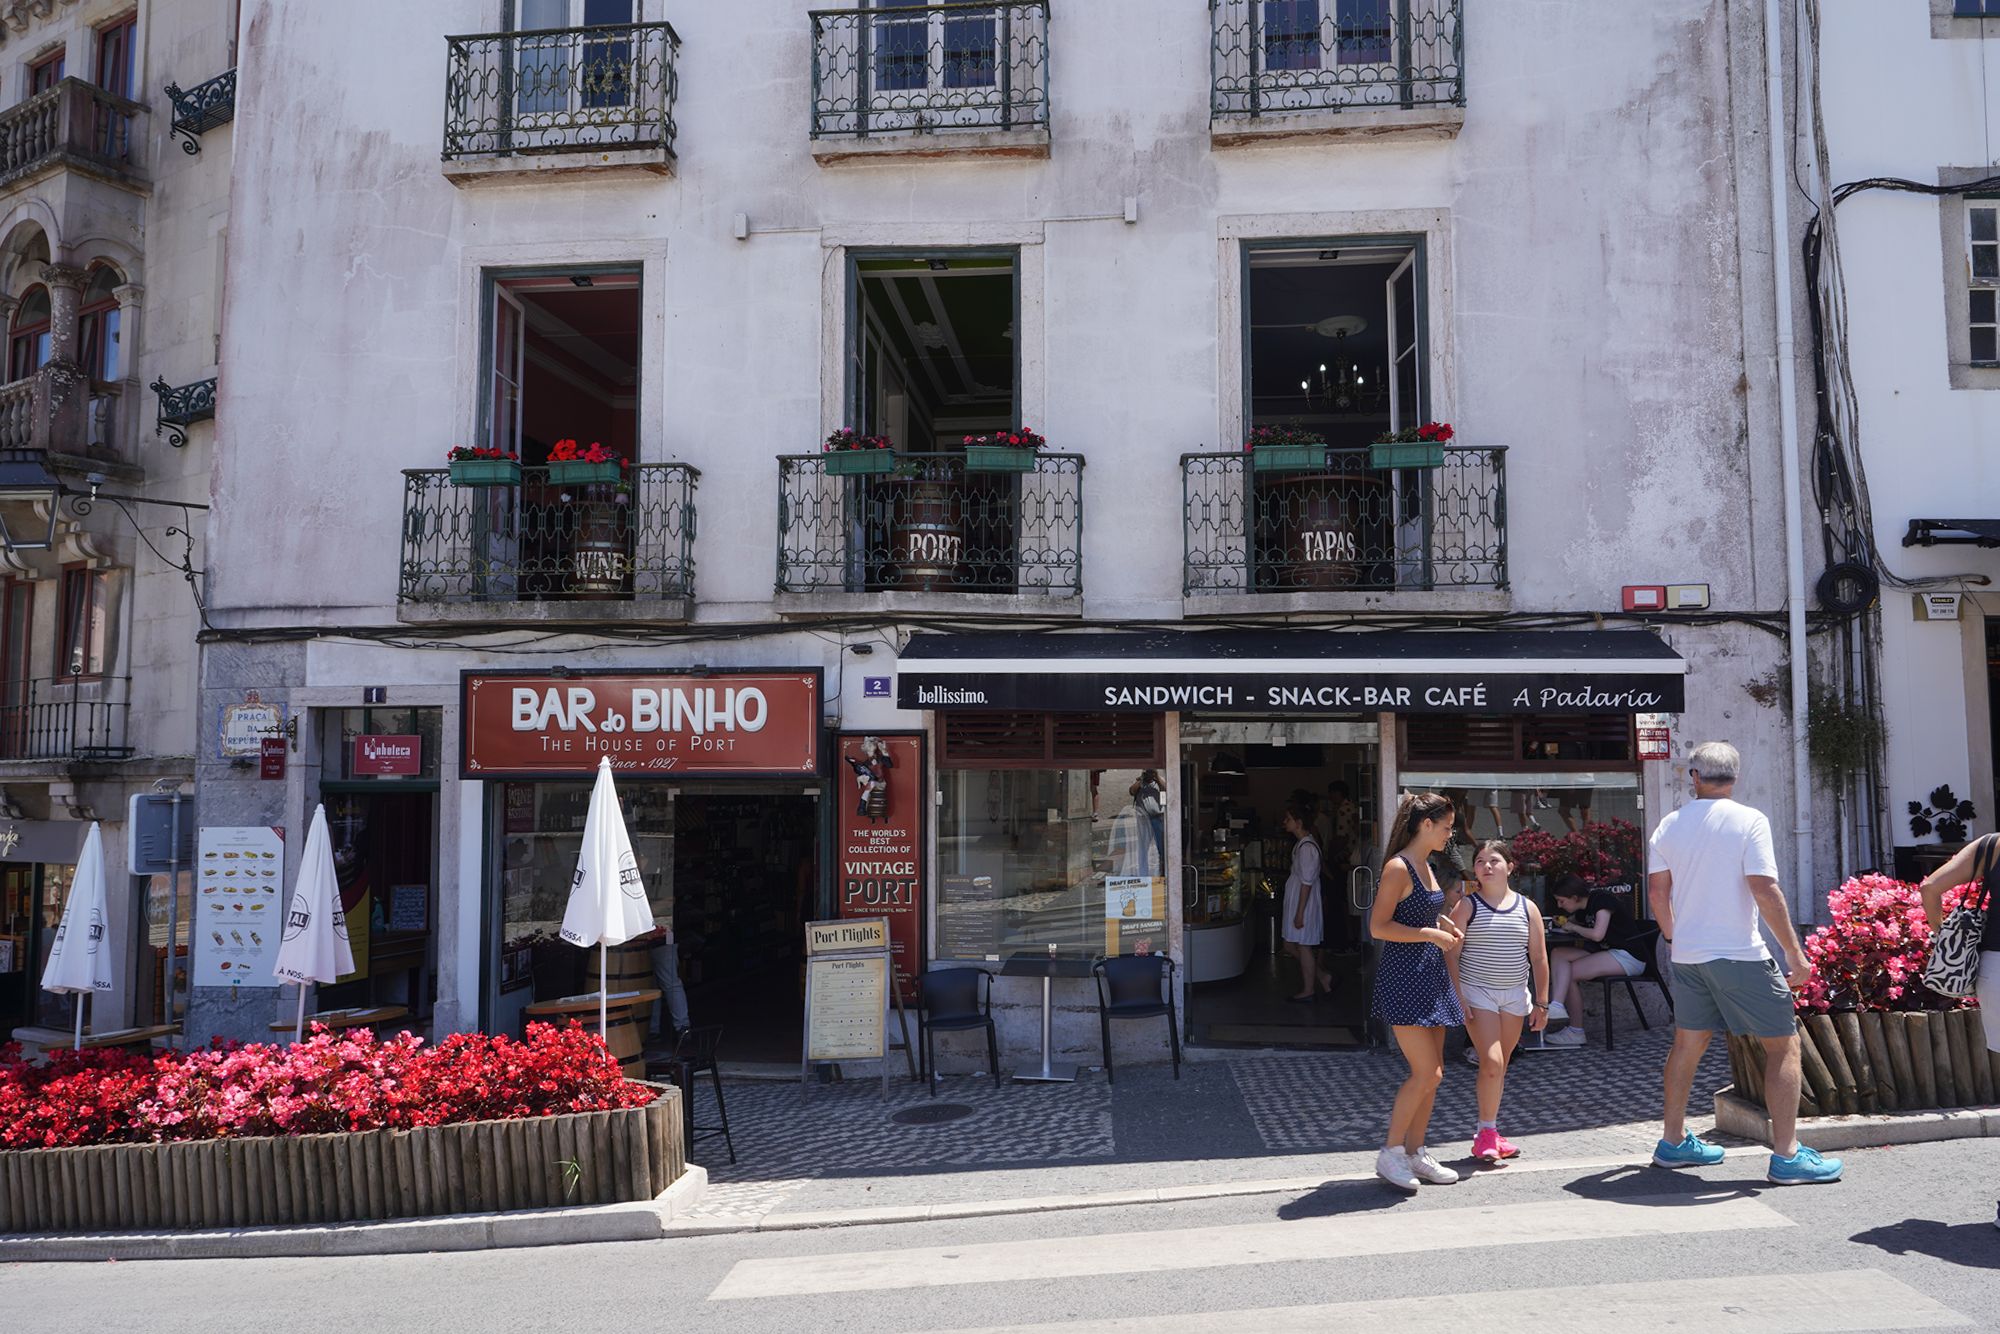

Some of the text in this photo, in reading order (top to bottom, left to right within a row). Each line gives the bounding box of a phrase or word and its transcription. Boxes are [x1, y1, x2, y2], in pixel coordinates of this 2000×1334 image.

[910, 533, 962, 565] PORT
[1301, 531, 1356, 561] TAPAS
[576, 551, 624, 580] WINE
[873, 680, 881, 690] 2
[372, 688, 377, 702] 1
[918, 685, 989, 704] bellissimo.
[1104, 686, 1233, 705] SANDWICH
[1267, 686, 1411, 706] SNACK-BAR
[1424, 682, 1488, 706] CAFÉ
[1512, 687, 1531, 707] A
[237, 713, 267, 722] PRAÇA
[512, 687, 768, 735] BAR do BINHO
[247, 725, 258, 733] DA
[228, 735, 262, 745] REPÚBL
[647, 757, 679, 770] 1927
[853, 829, 906, 837] THE WORLD'S
[848, 846, 898, 854] COLLECTION
[845, 862, 915, 875] VINTAGE
[844, 878, 918, 905] PORT
[561, 927, 582, 943] NOSSA
[814, 926, 881, 944] Port Flights
[831, 962, 844, 970] Port
